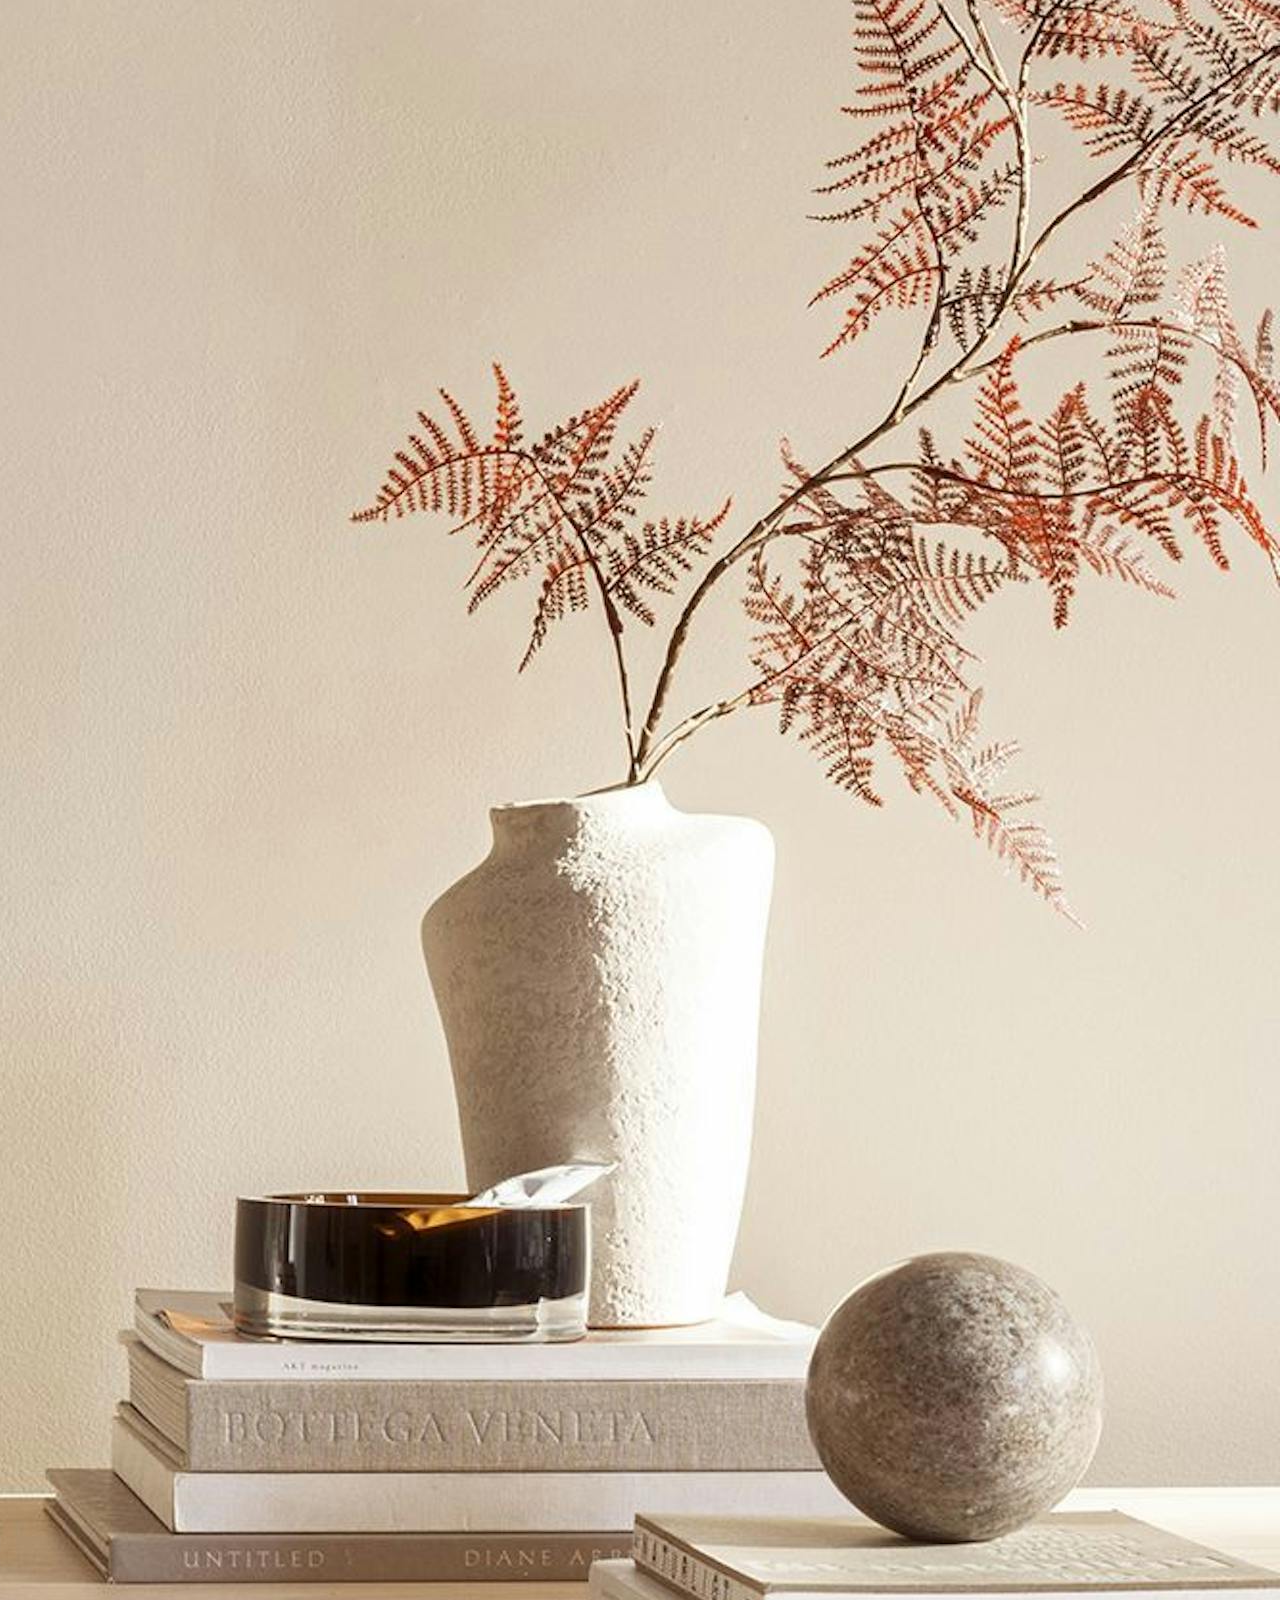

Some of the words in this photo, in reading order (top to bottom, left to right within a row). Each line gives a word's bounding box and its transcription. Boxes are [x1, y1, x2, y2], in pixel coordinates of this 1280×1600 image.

[222, 1411, 446, 1444] BOTTEGA
[466, 1411, 658, 1444] VENETA
[182, 1549, 325, 1569] UNTITLED
[464, 1548, 553, 1567] DIANE
